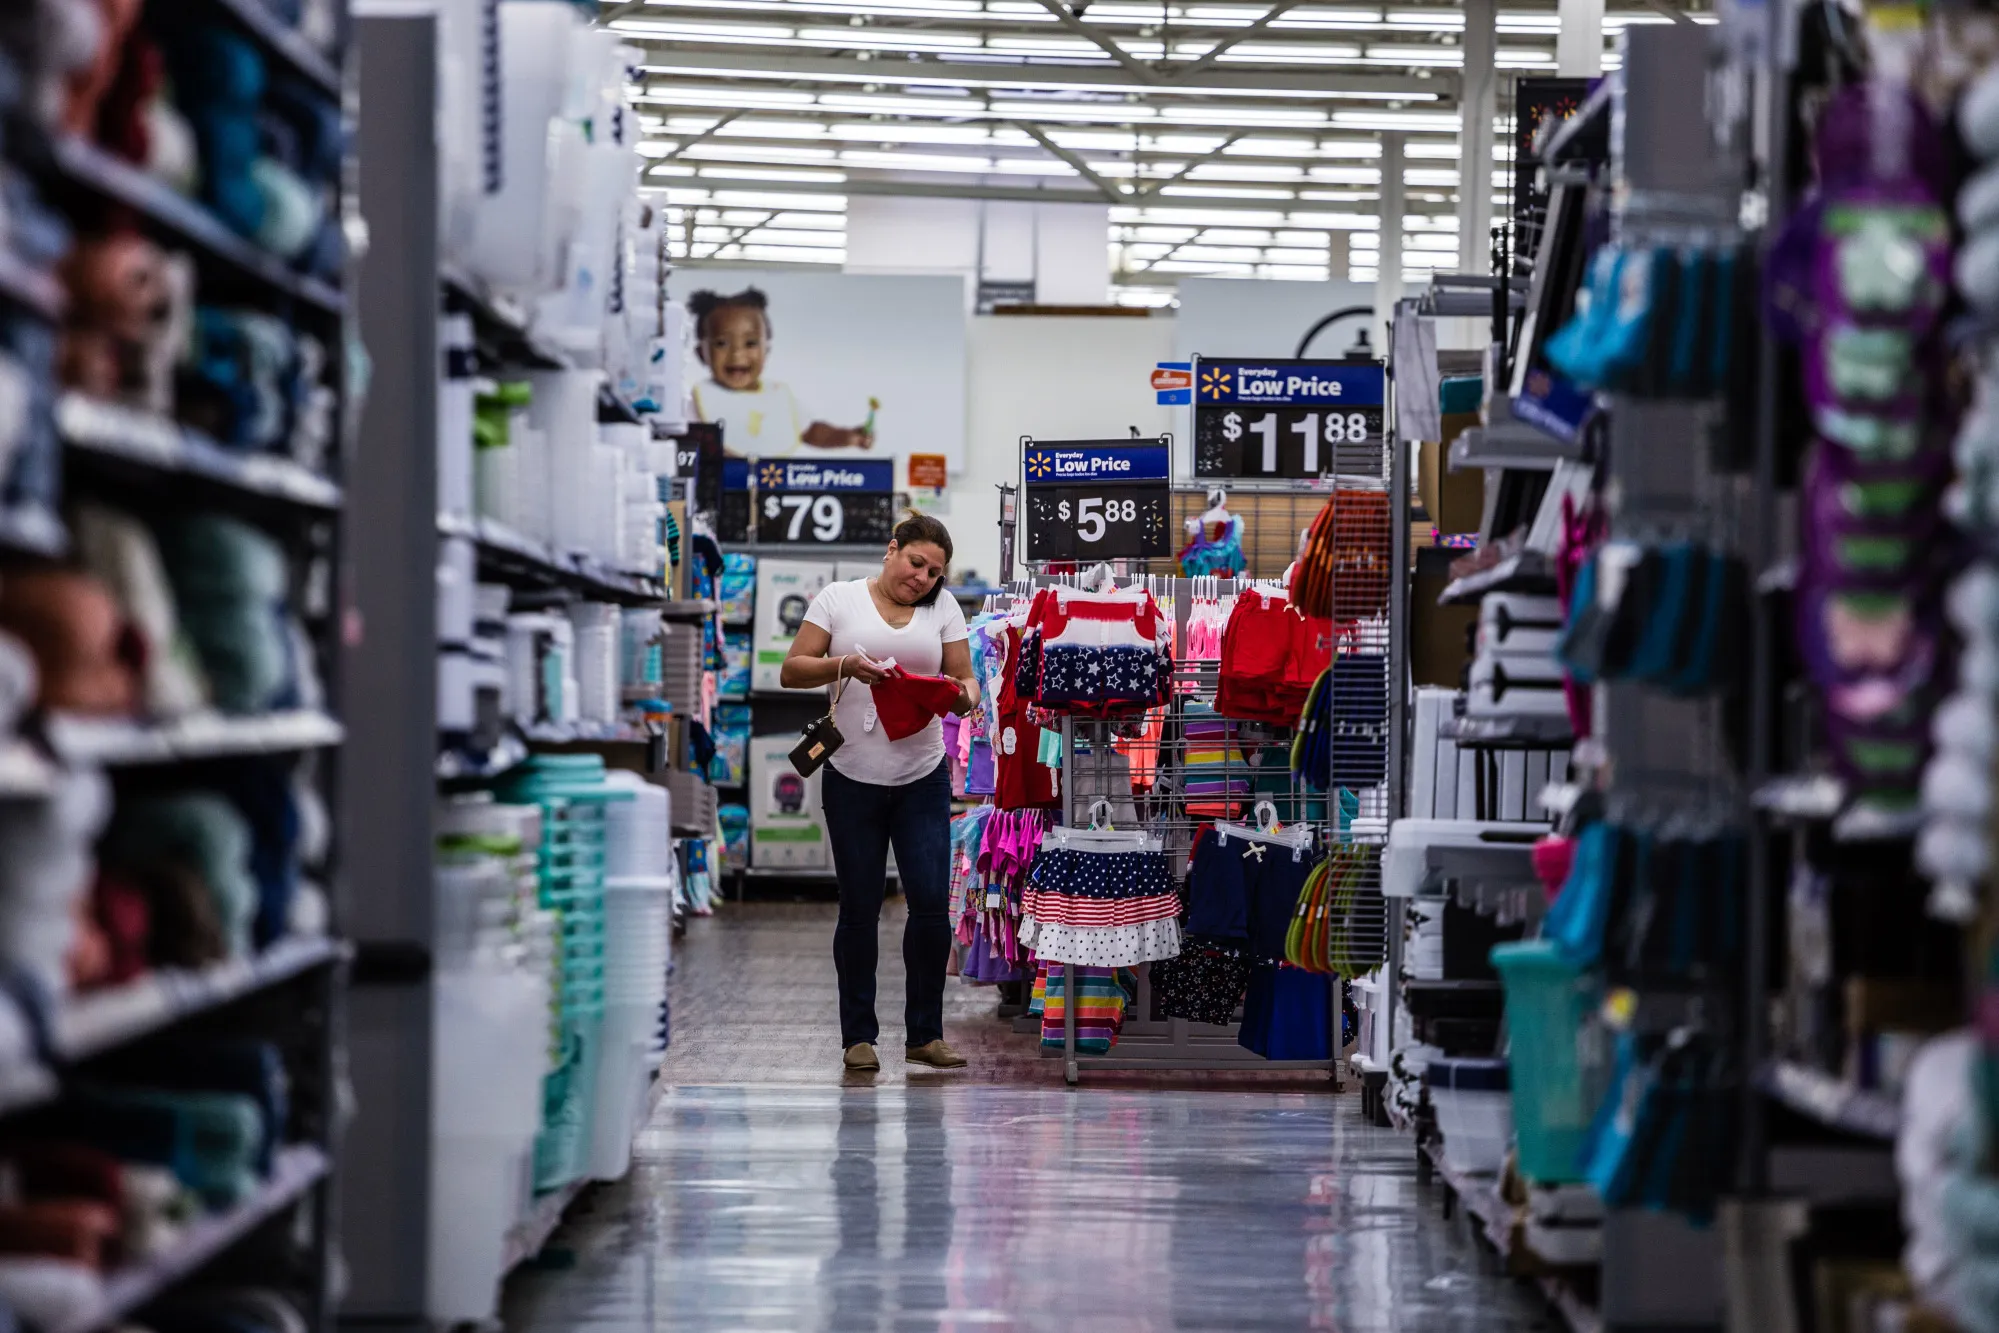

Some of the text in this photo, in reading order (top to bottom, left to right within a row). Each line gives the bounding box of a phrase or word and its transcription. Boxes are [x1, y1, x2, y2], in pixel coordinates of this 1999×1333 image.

[1238, 367, 1278, 378] Everyday
[1238, 376, 1342, 396] Low Price
[678, 451, 697, 467] 97
[1055, 452, 1083, 460] Everyday
[1055, 457, 1130, 472] Low Price
[786, 468, 865, 487] Low Price
